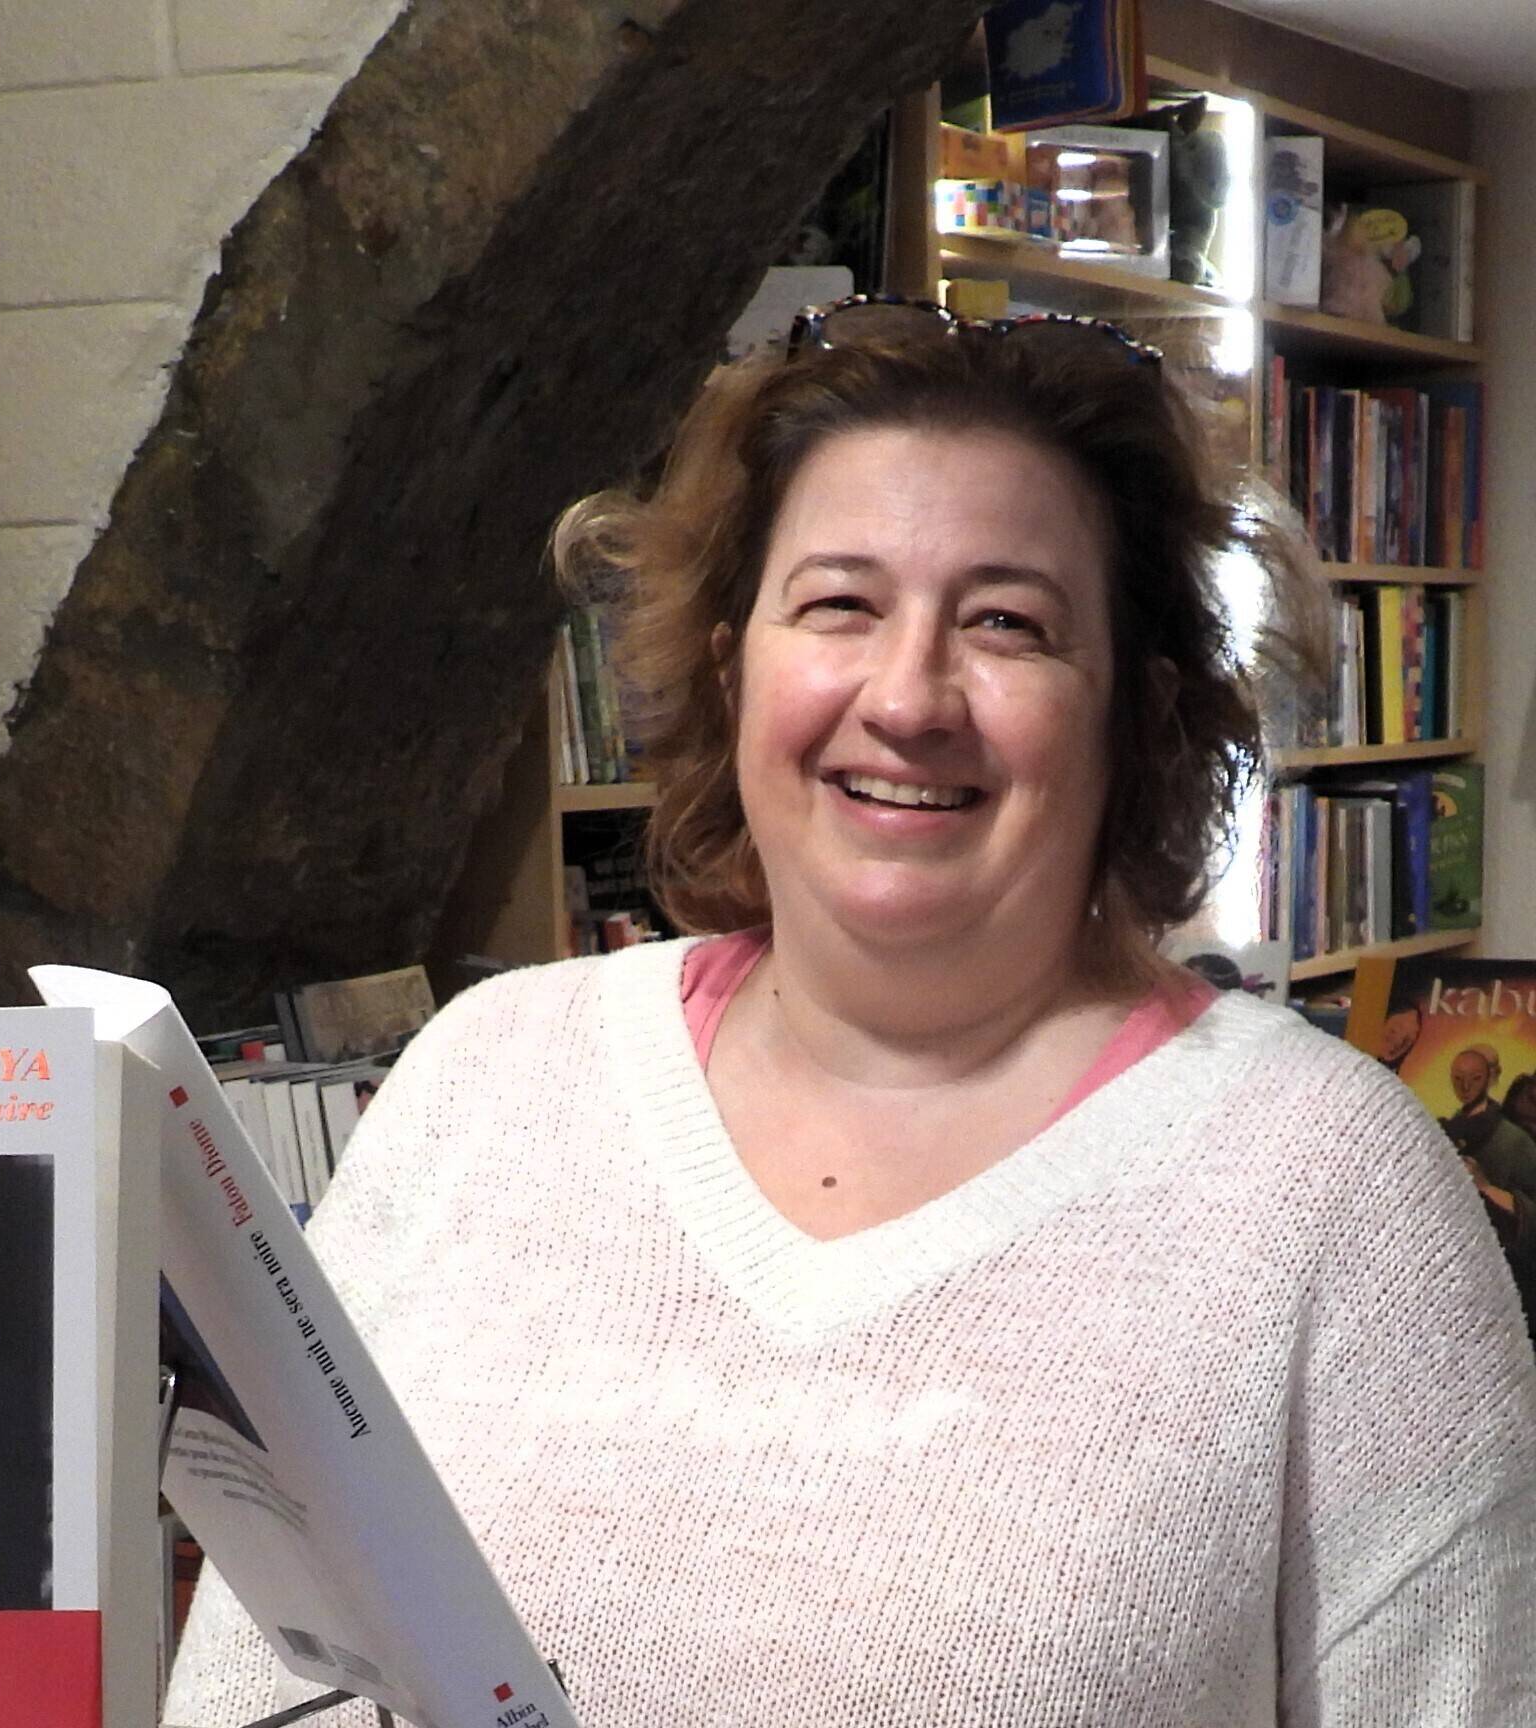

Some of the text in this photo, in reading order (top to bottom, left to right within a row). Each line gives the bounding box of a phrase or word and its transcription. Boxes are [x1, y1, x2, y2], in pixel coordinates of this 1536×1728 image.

[190, 1117, 372, 1440] Aucune nuit ne sera noire Fatou Diome
